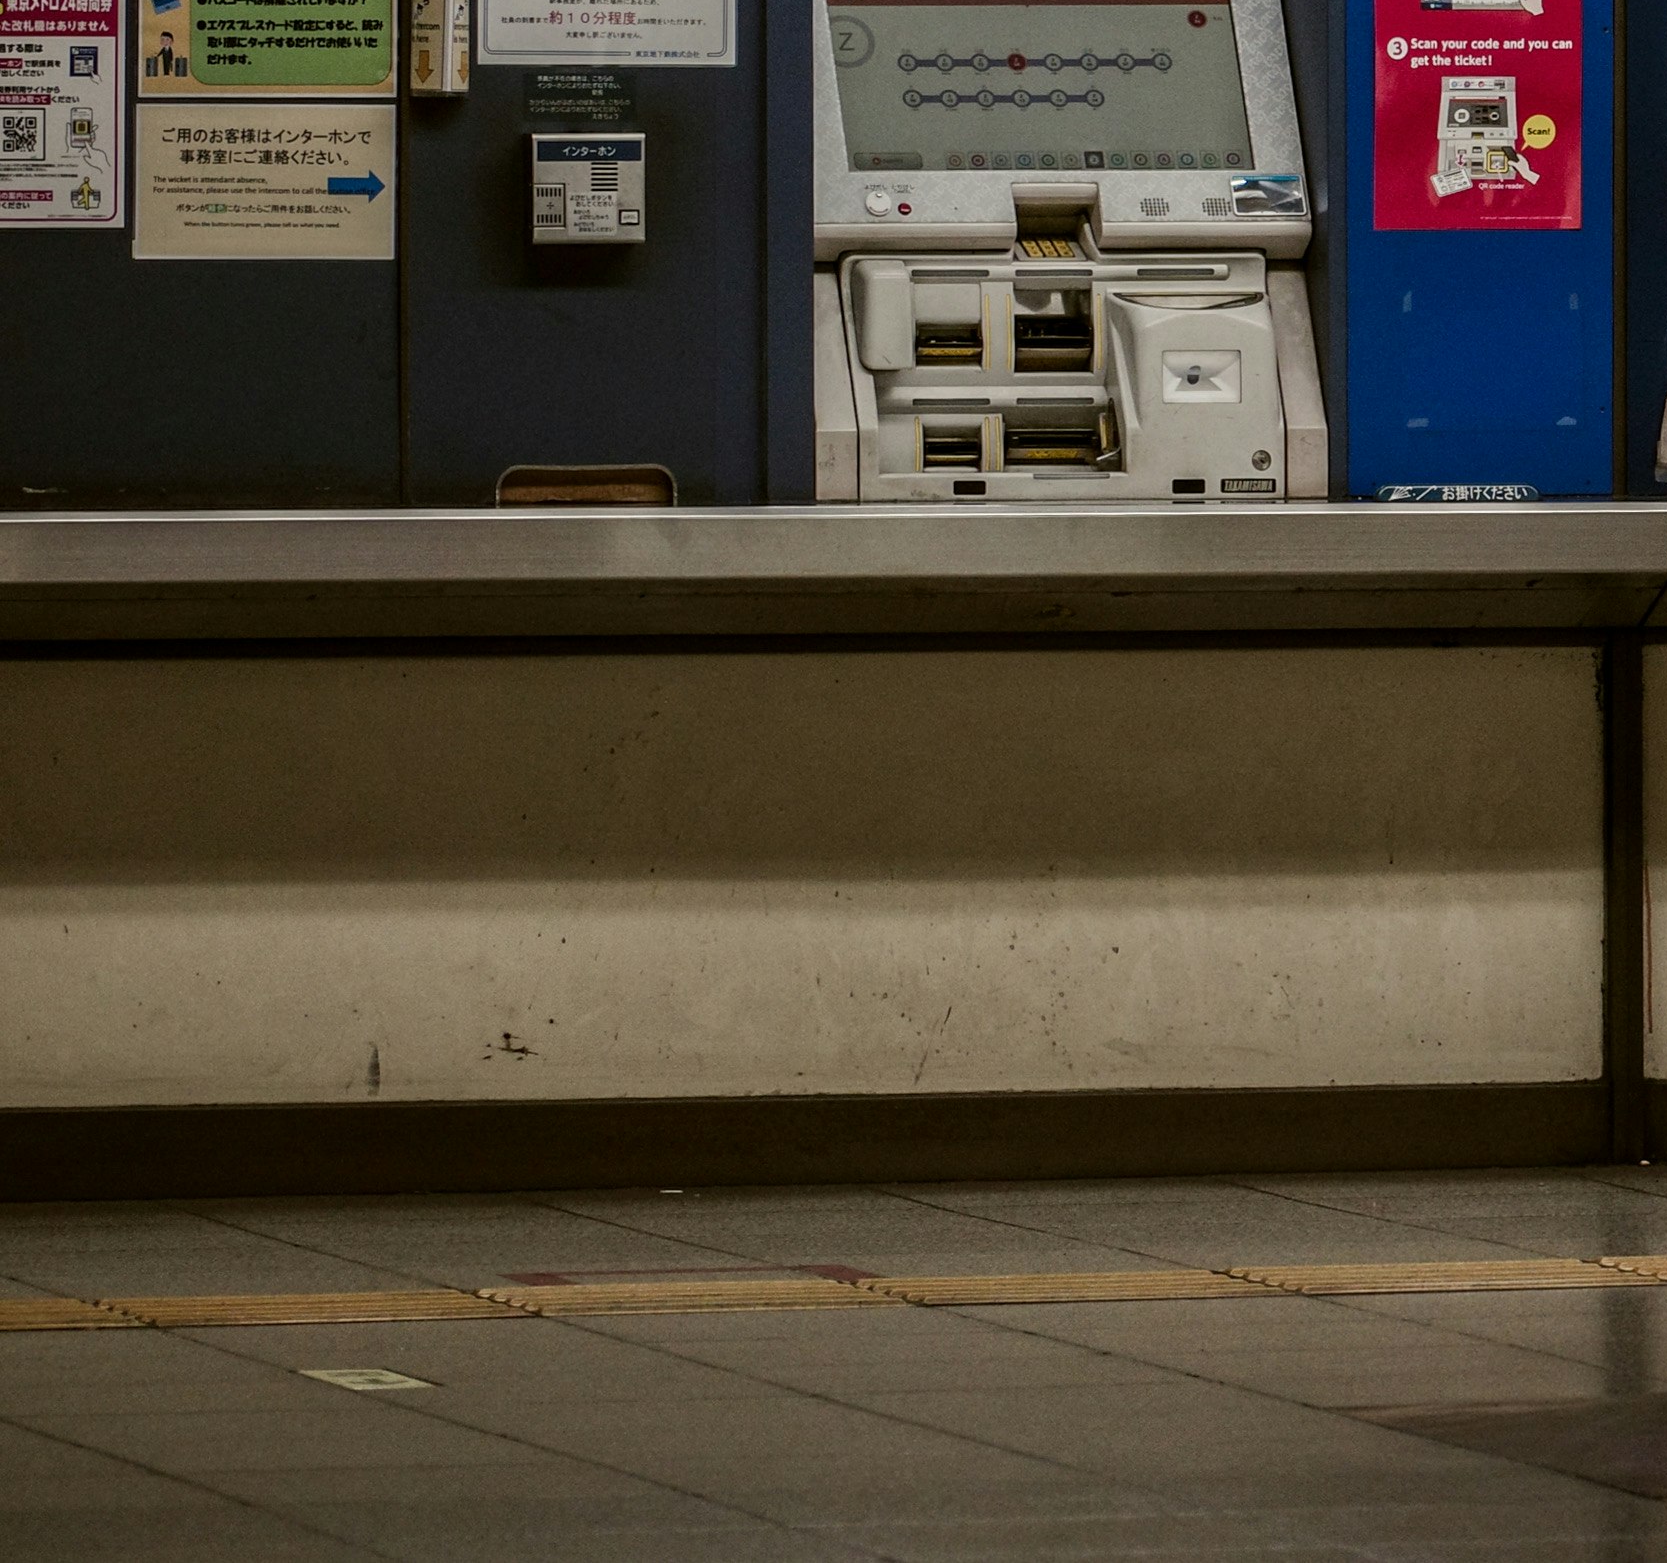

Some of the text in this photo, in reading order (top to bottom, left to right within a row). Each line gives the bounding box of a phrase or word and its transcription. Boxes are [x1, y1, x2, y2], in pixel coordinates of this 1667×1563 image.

[1410, 38, 1438, 50] Scan
[1441, 38, 1468, 54] your
[1470, 38, 1500, 50] code
[1503, 38, 1525, 50] and
[1528, 39, 1552, 54] you
[1554, 39, 1573, 50] can
[207, 54, 252, 65] だけます。
[1410, 54, 1493, 69] get the ticket!
[162, 128, 372, 144] ご用のお客様はインターホンで
[1527, 127, 1551, 136] Scan!
[180, 150, 350, 166] 事務室にご連絡ください。
[562, 146, 617, 156] インターホン
[1441, 486, 1527, 501] お掛けください
